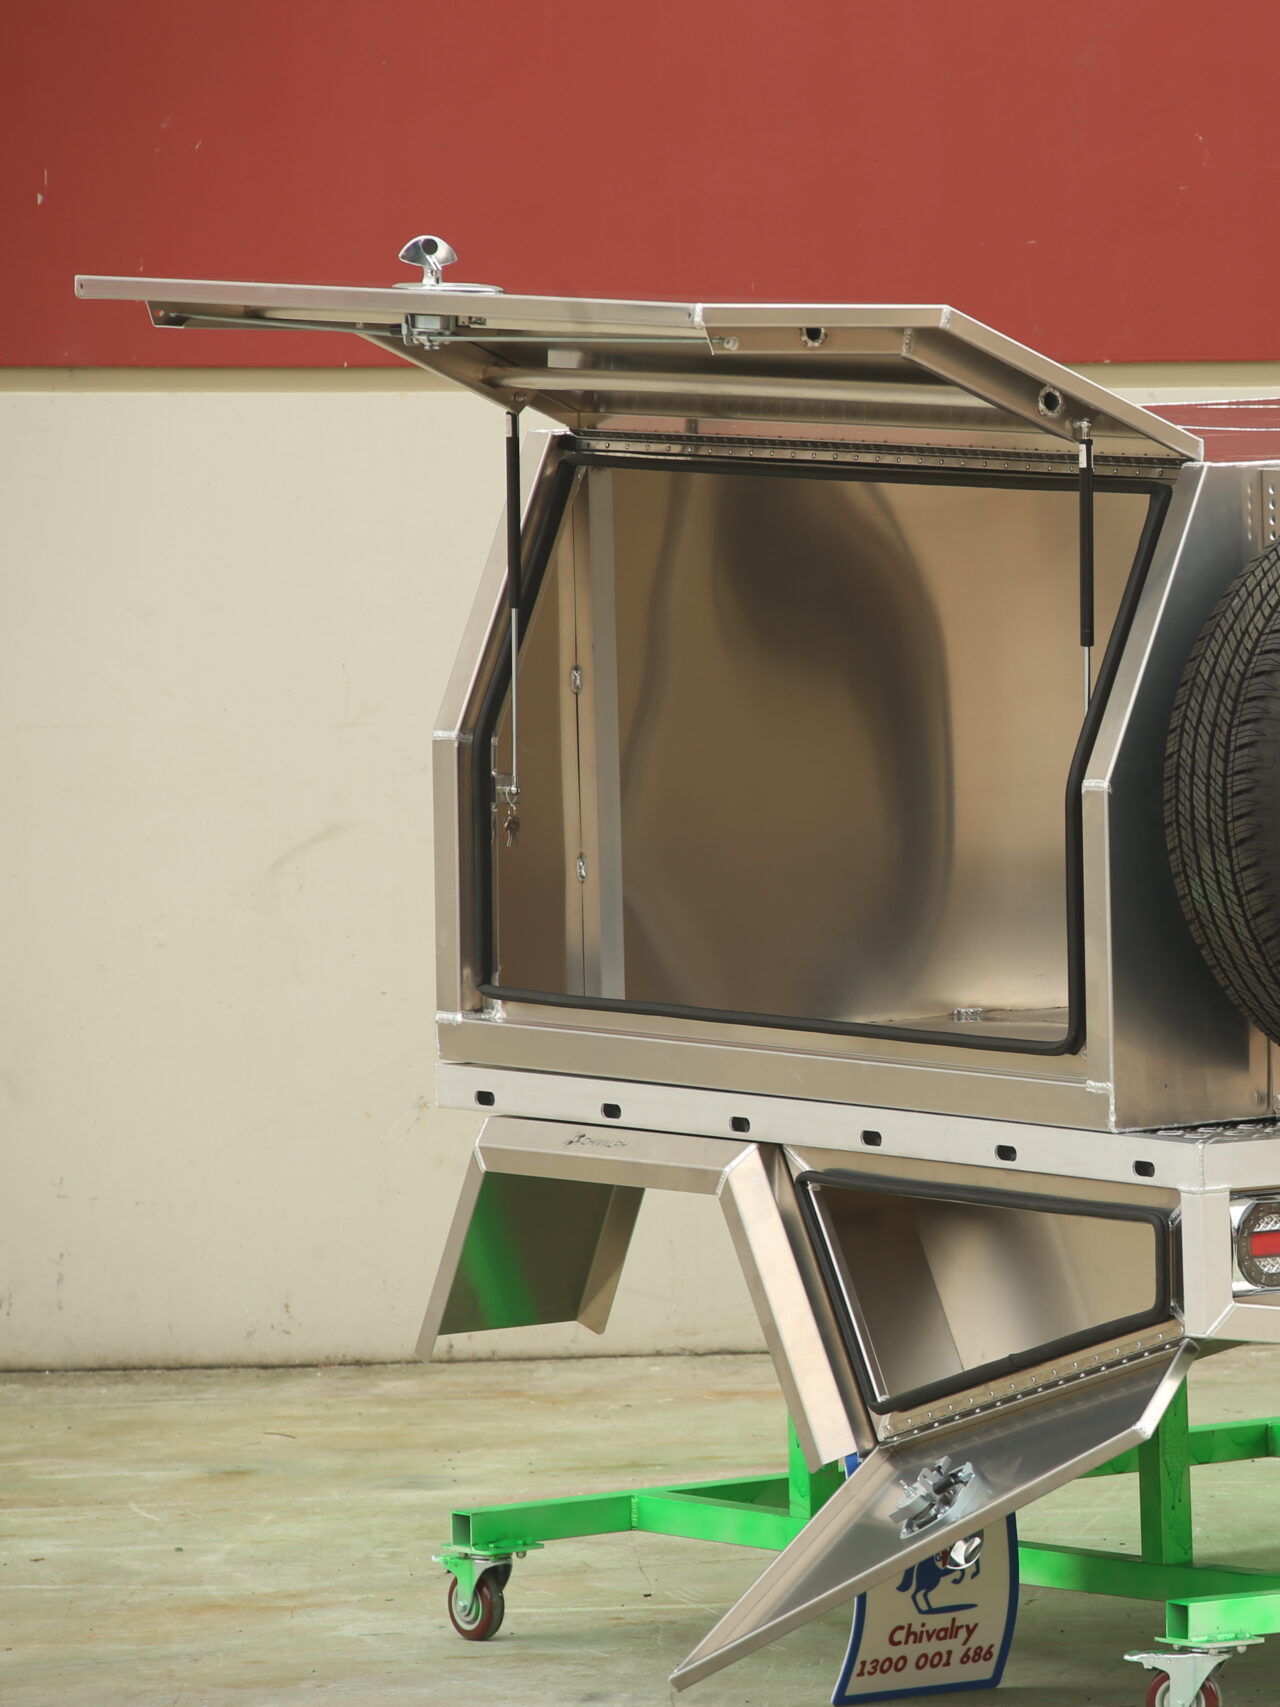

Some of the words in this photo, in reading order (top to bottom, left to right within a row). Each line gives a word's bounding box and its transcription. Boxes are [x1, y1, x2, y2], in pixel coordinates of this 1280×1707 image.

[888, 1617, 979, 1646] Chivalry
[857, 1656, 907, 1677] 1300
[915, 1650, 953, 1669] 001
[960, 1644, 994, 1664] 686
